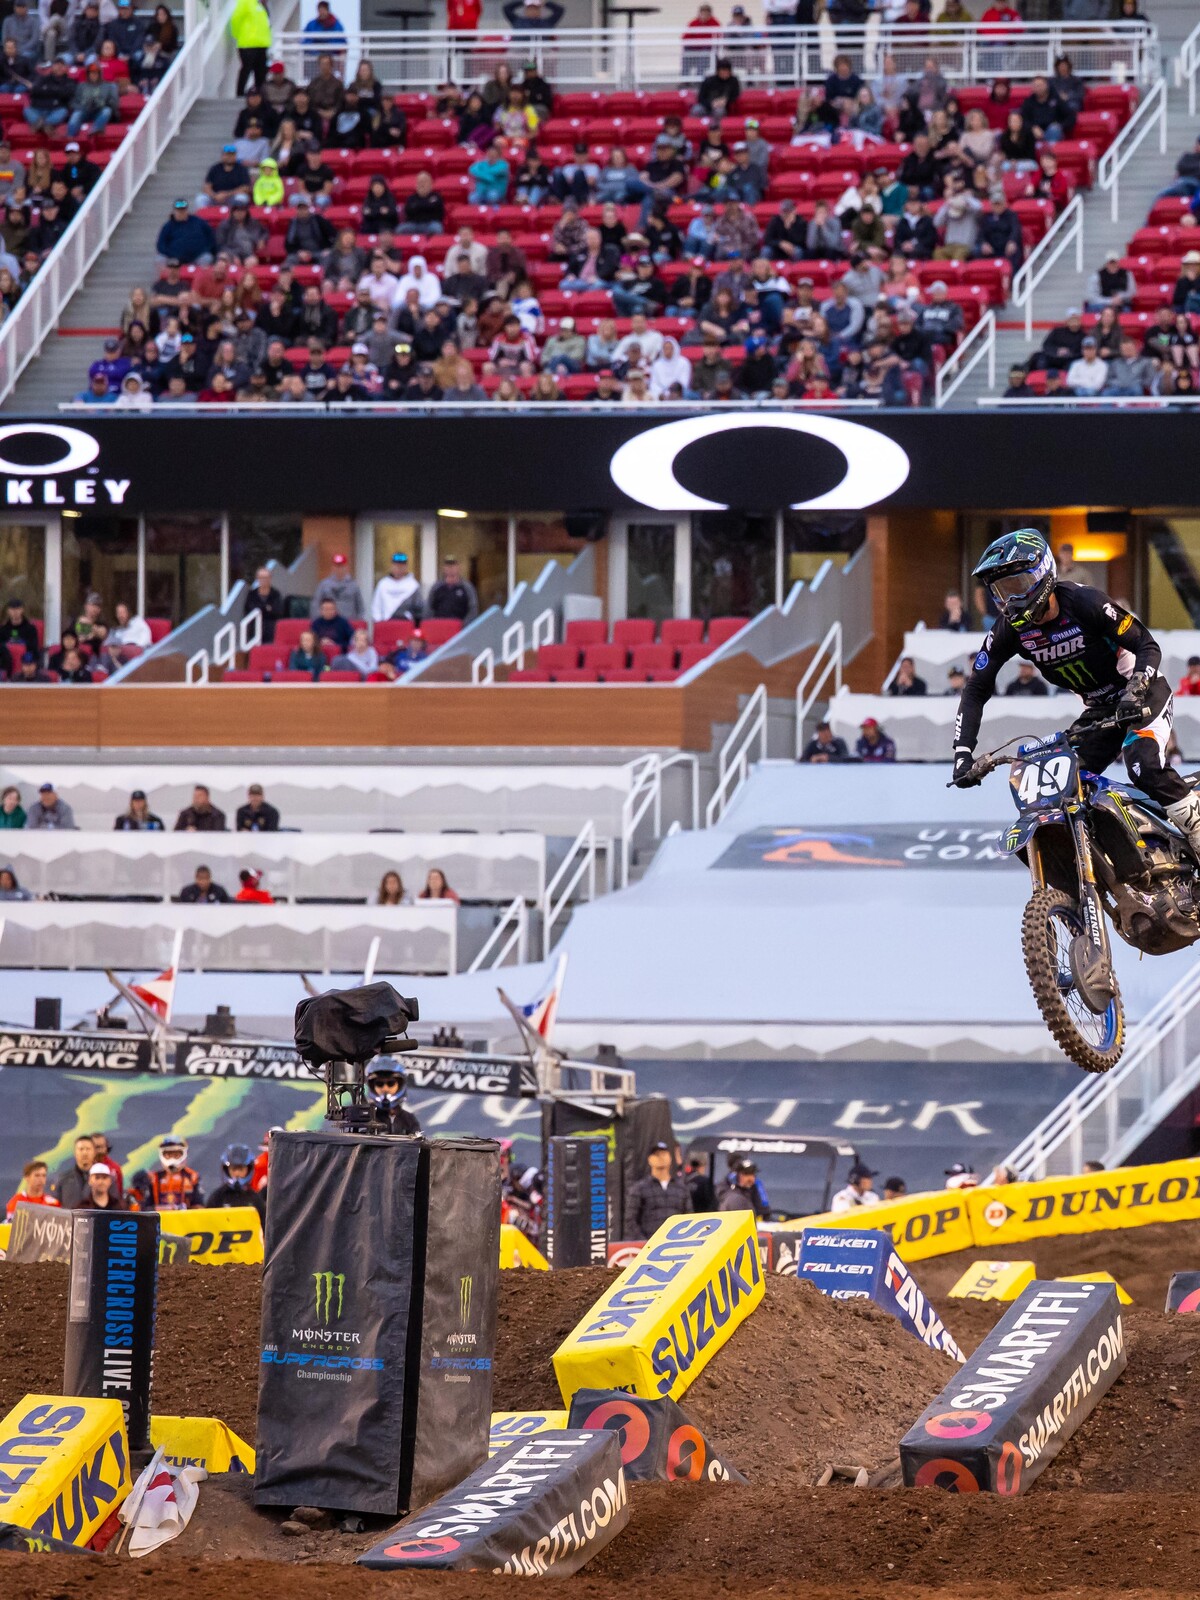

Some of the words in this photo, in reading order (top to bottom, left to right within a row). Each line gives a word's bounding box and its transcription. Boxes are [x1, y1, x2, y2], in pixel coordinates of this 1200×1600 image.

[1031, 635, 1086, 662] THOR
[1018, 756, 1071, 805] 49
[918, 828, 1002, 842] UTA
[1087, 897, 1101, 947] DUNLOP
[18, 1034, 63, 1049] ROCKY
[65, 1037, 139, 1053] MOUNTAIN
[209, 1044, 254, 1060] ROCKY
[436, 1058, 512, 1076] MOUNTAIN
[806, 1235, 877, 1249] FALKEN
[802, 1262, 874, 1275] FALKEN
[577, 1218, 722, 1343] SUZUKI
[651, 1235, 760, 1395] SUZUKI
[292, 1327, 361, 1344] MONSTER
[264, 1344, 278, 1352] AMA
[302, 1342, 350, 1351] ENERGY
[260, 1350, 386, 1372] SUPERCROSS
[296, 1369, 352, 1383] Championship
[1018, 1315, 1124, 1469] SMARTFI.COM
[493, 1468, 627, 1577] MARTFI.COM
